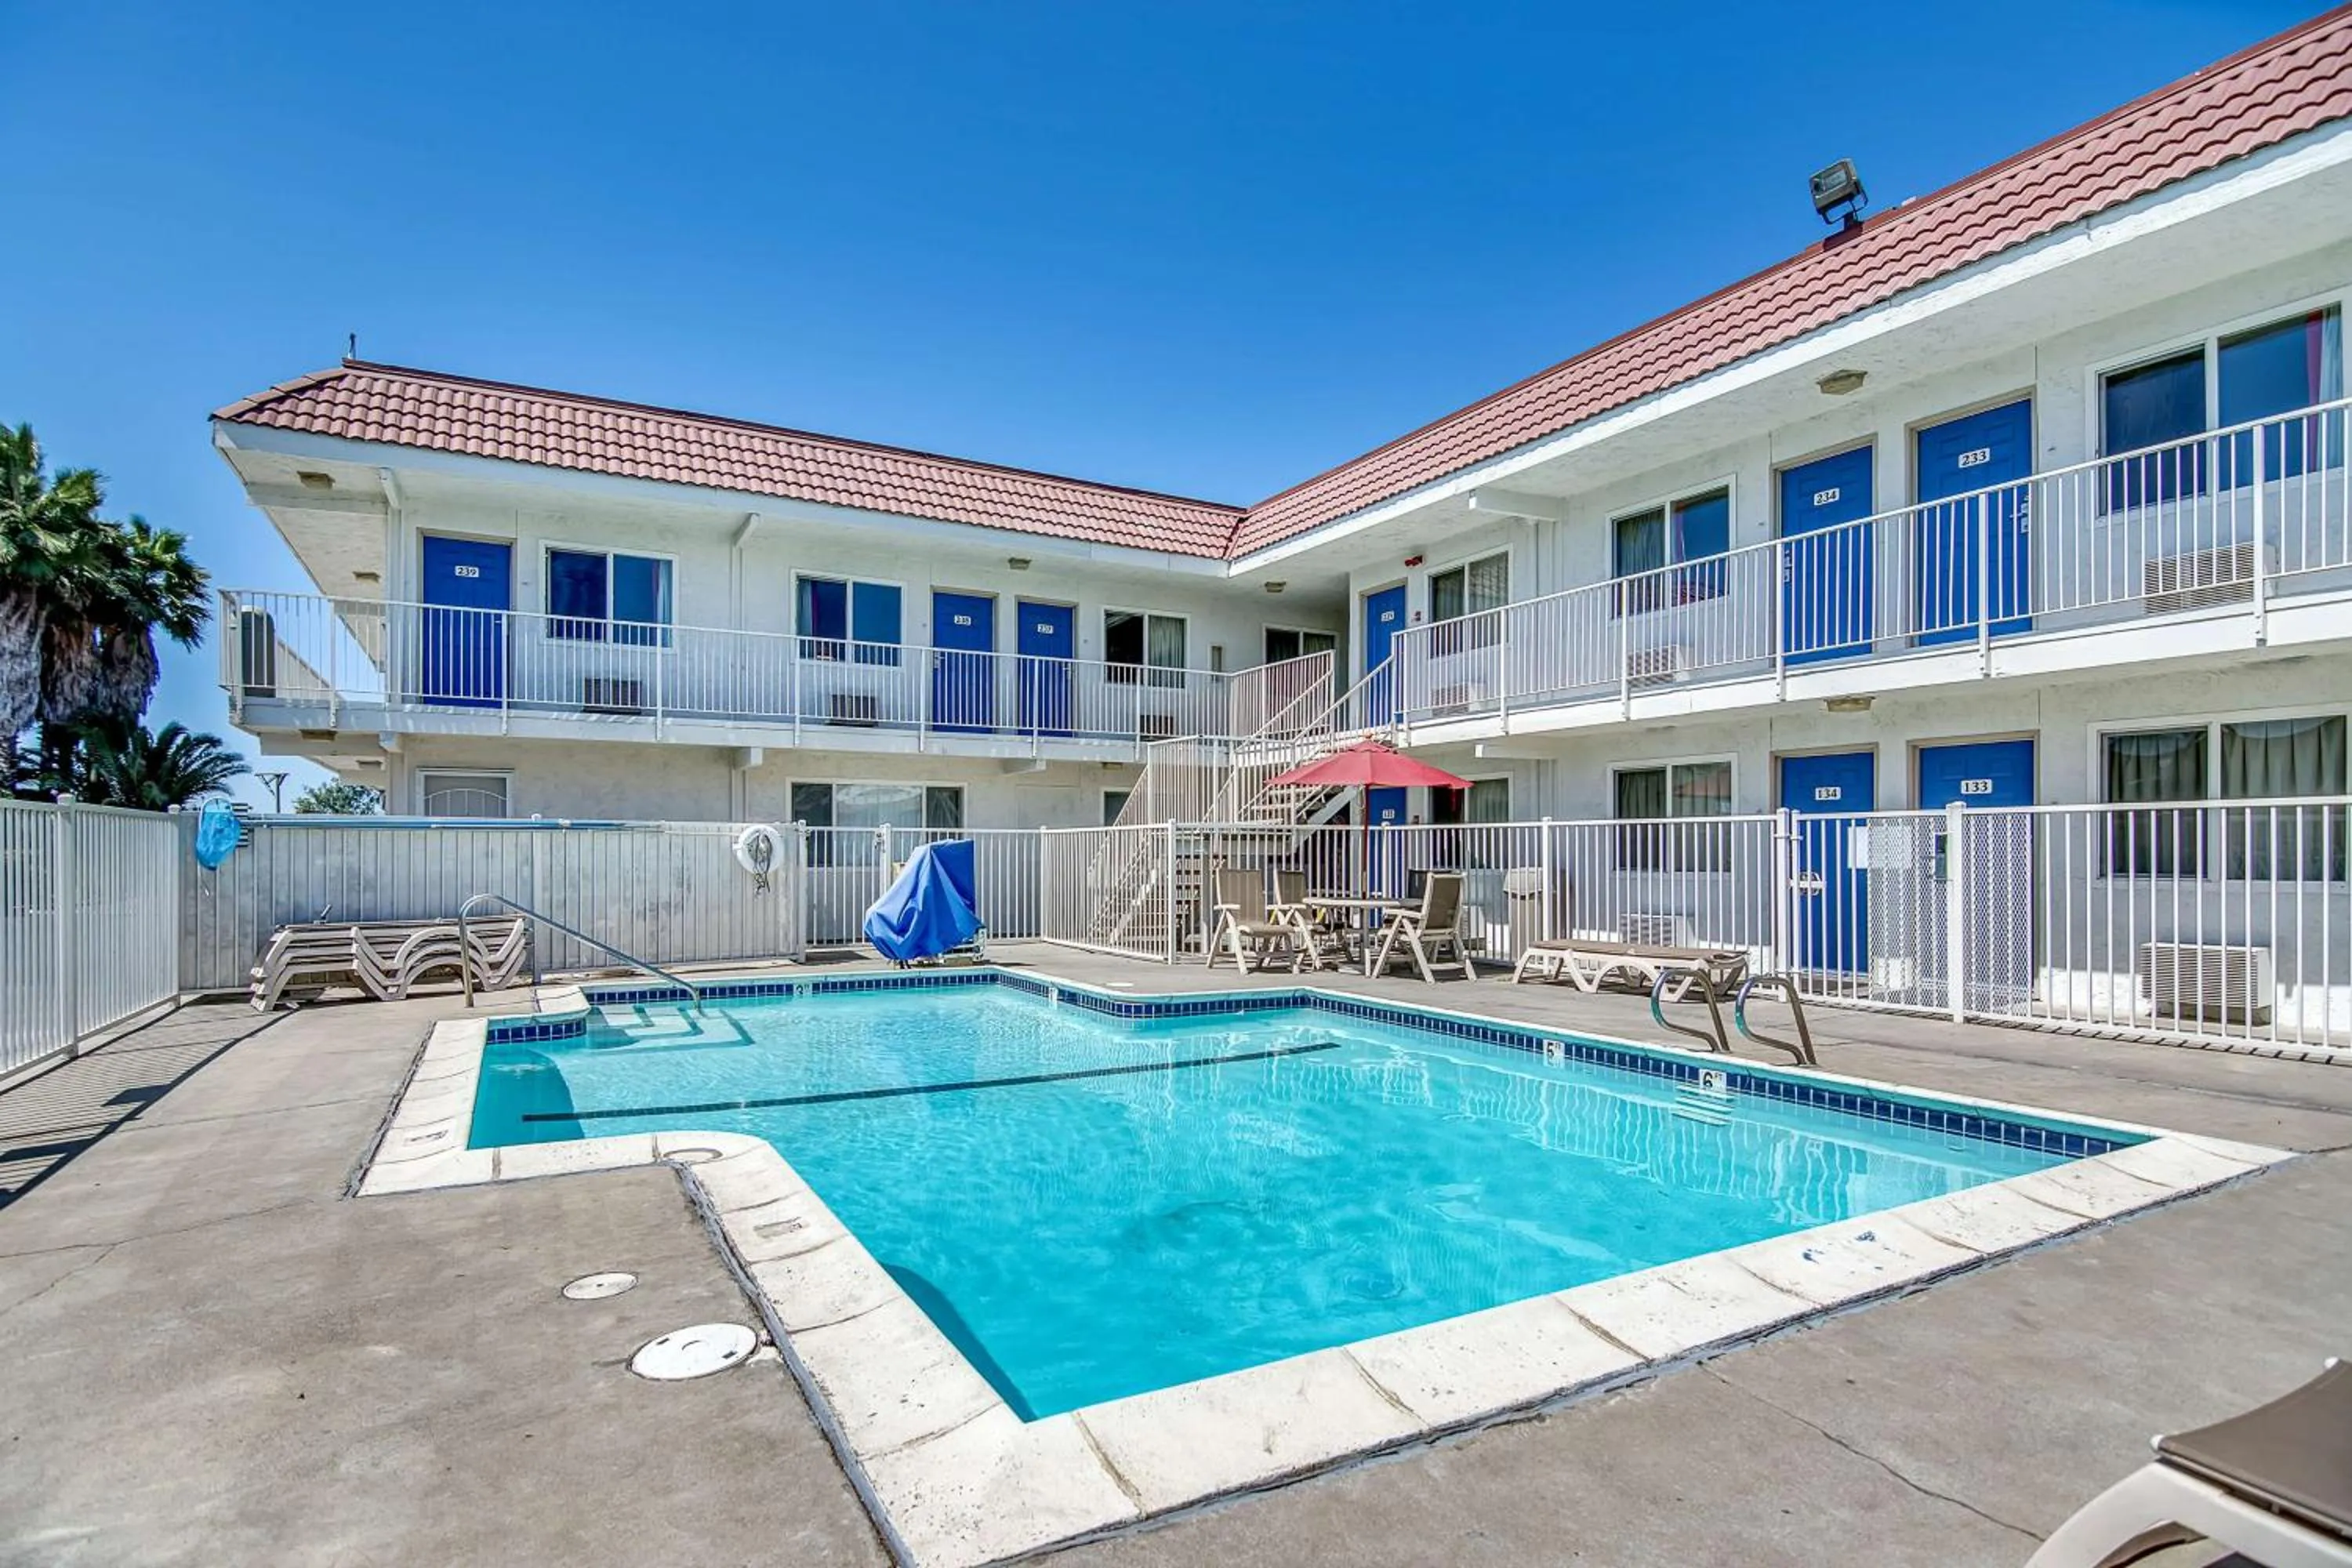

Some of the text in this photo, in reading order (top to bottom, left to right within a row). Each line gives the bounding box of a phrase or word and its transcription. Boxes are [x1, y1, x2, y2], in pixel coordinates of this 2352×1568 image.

[1962, 451, 1987, 466] 233
[1817, 490, 1837, 504] 234
[457, 567, 477, 576] 239
[1818, 788, 1838, 798] 134
[1963, 781, 1988, 793] 133
[1547, 1041, 1555, 1058] 5
[1703, 1071, 1713, 1088] 6
